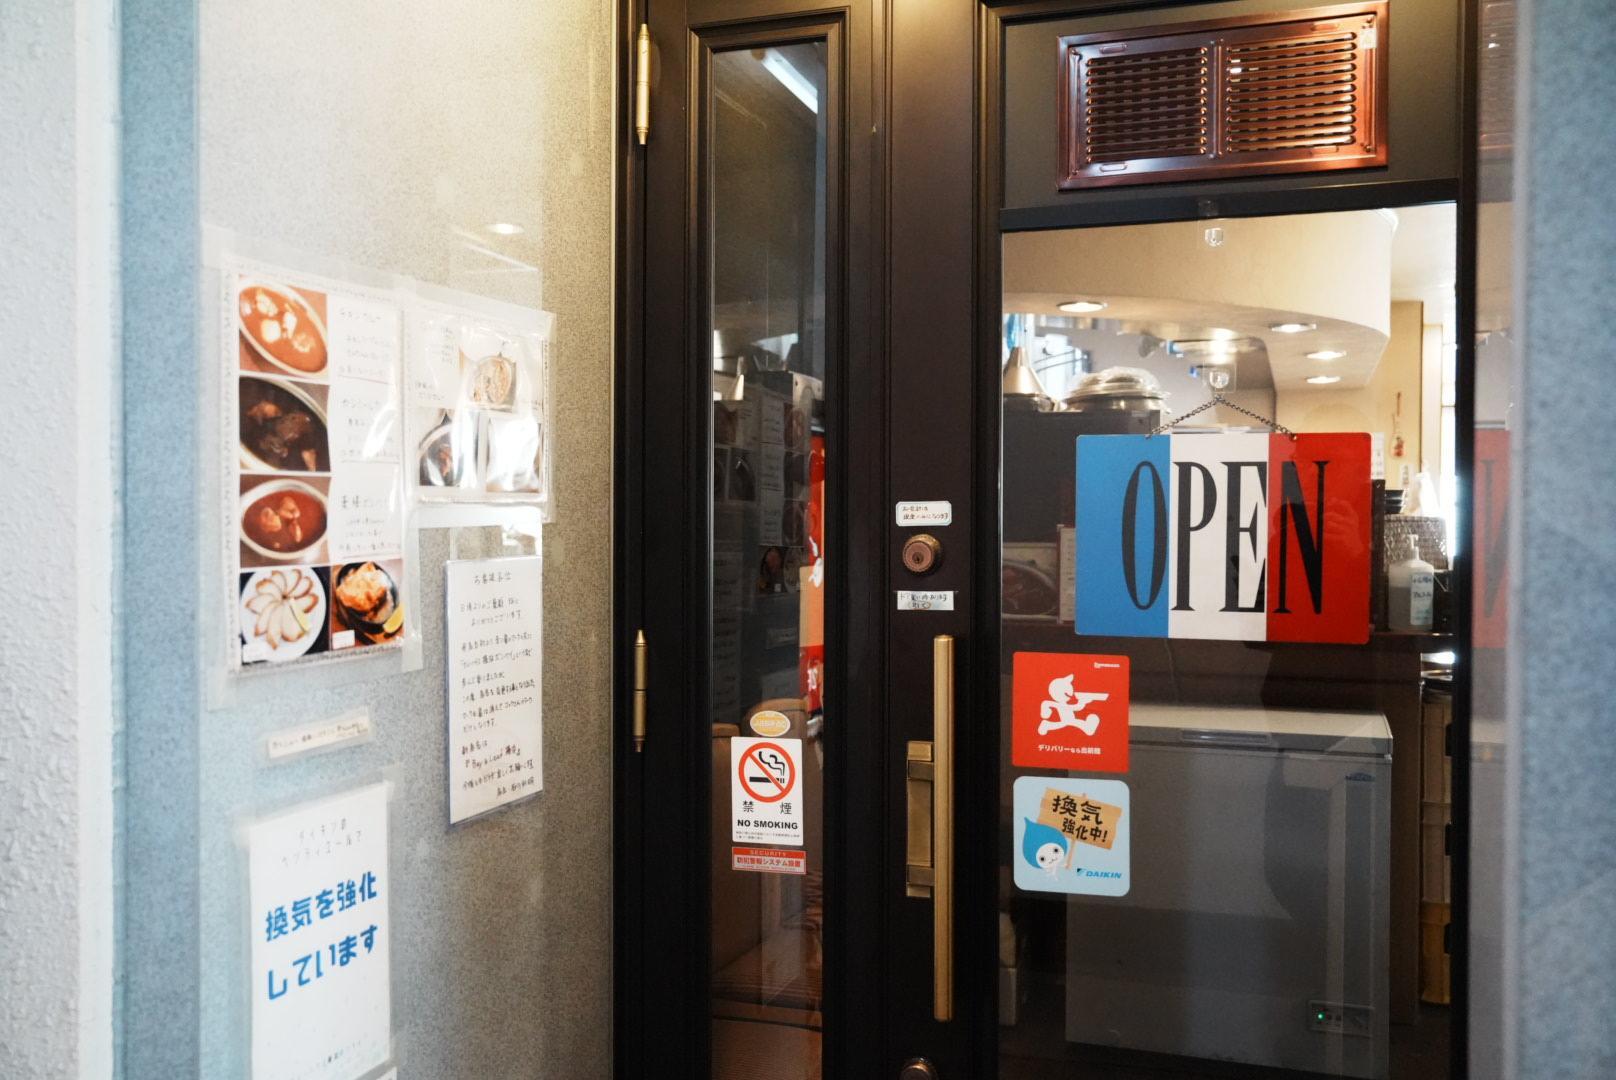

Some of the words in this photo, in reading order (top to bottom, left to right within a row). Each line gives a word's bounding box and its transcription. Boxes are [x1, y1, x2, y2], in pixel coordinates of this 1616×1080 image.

[1121, 460, 1331, 615] OPEN
[737, 819, 751, 827] NO
[753, 820, 798, 830] SMOKING
[1052, 795, 1103, 826] 換気
[1061, 817, 1108, 843] 強化中!
[749, 849, 787, 857] SECURITY
[1085, 870, 1122, 879] DAIKIN
[265, 871, 377, 942] 換気を強化
[267, 924, 379, 1001] しています
